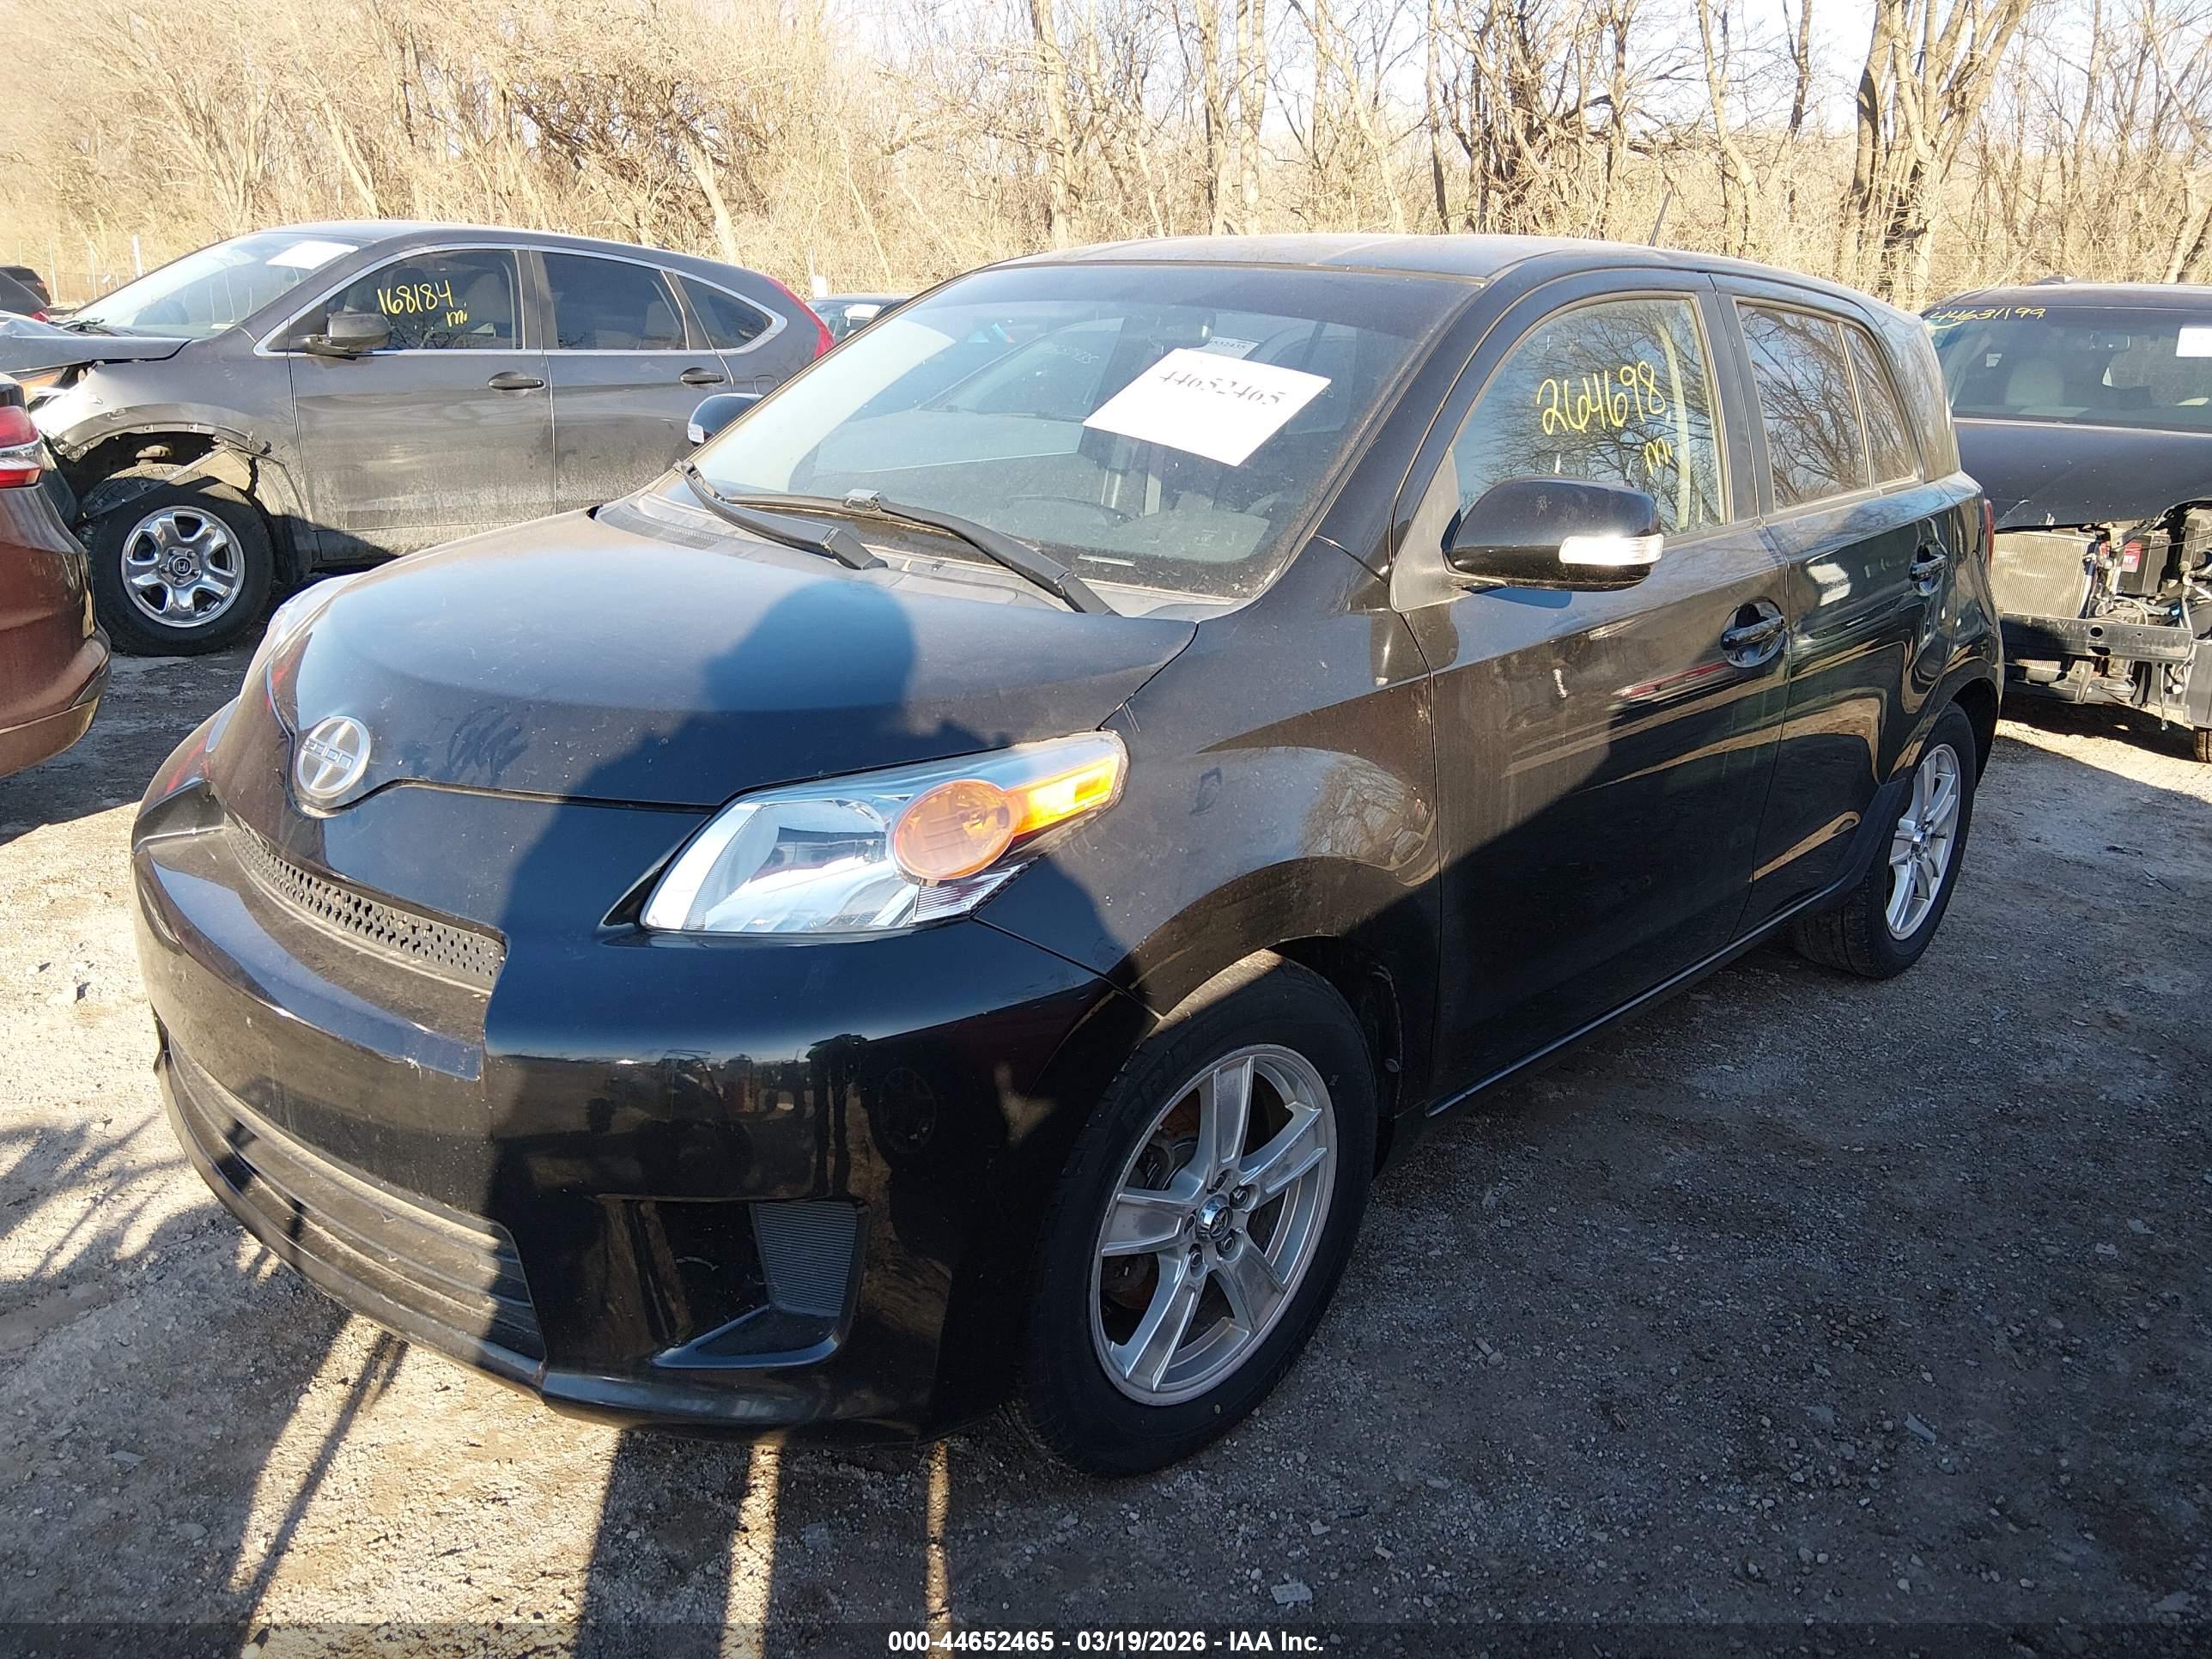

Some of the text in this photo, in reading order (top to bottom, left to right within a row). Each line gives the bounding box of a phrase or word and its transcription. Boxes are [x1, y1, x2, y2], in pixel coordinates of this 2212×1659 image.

[377, 279, 453, 315] 168184
[1929, 307, 2046, 322] 44631199
[1536, 360, 1666, 435] 264698
